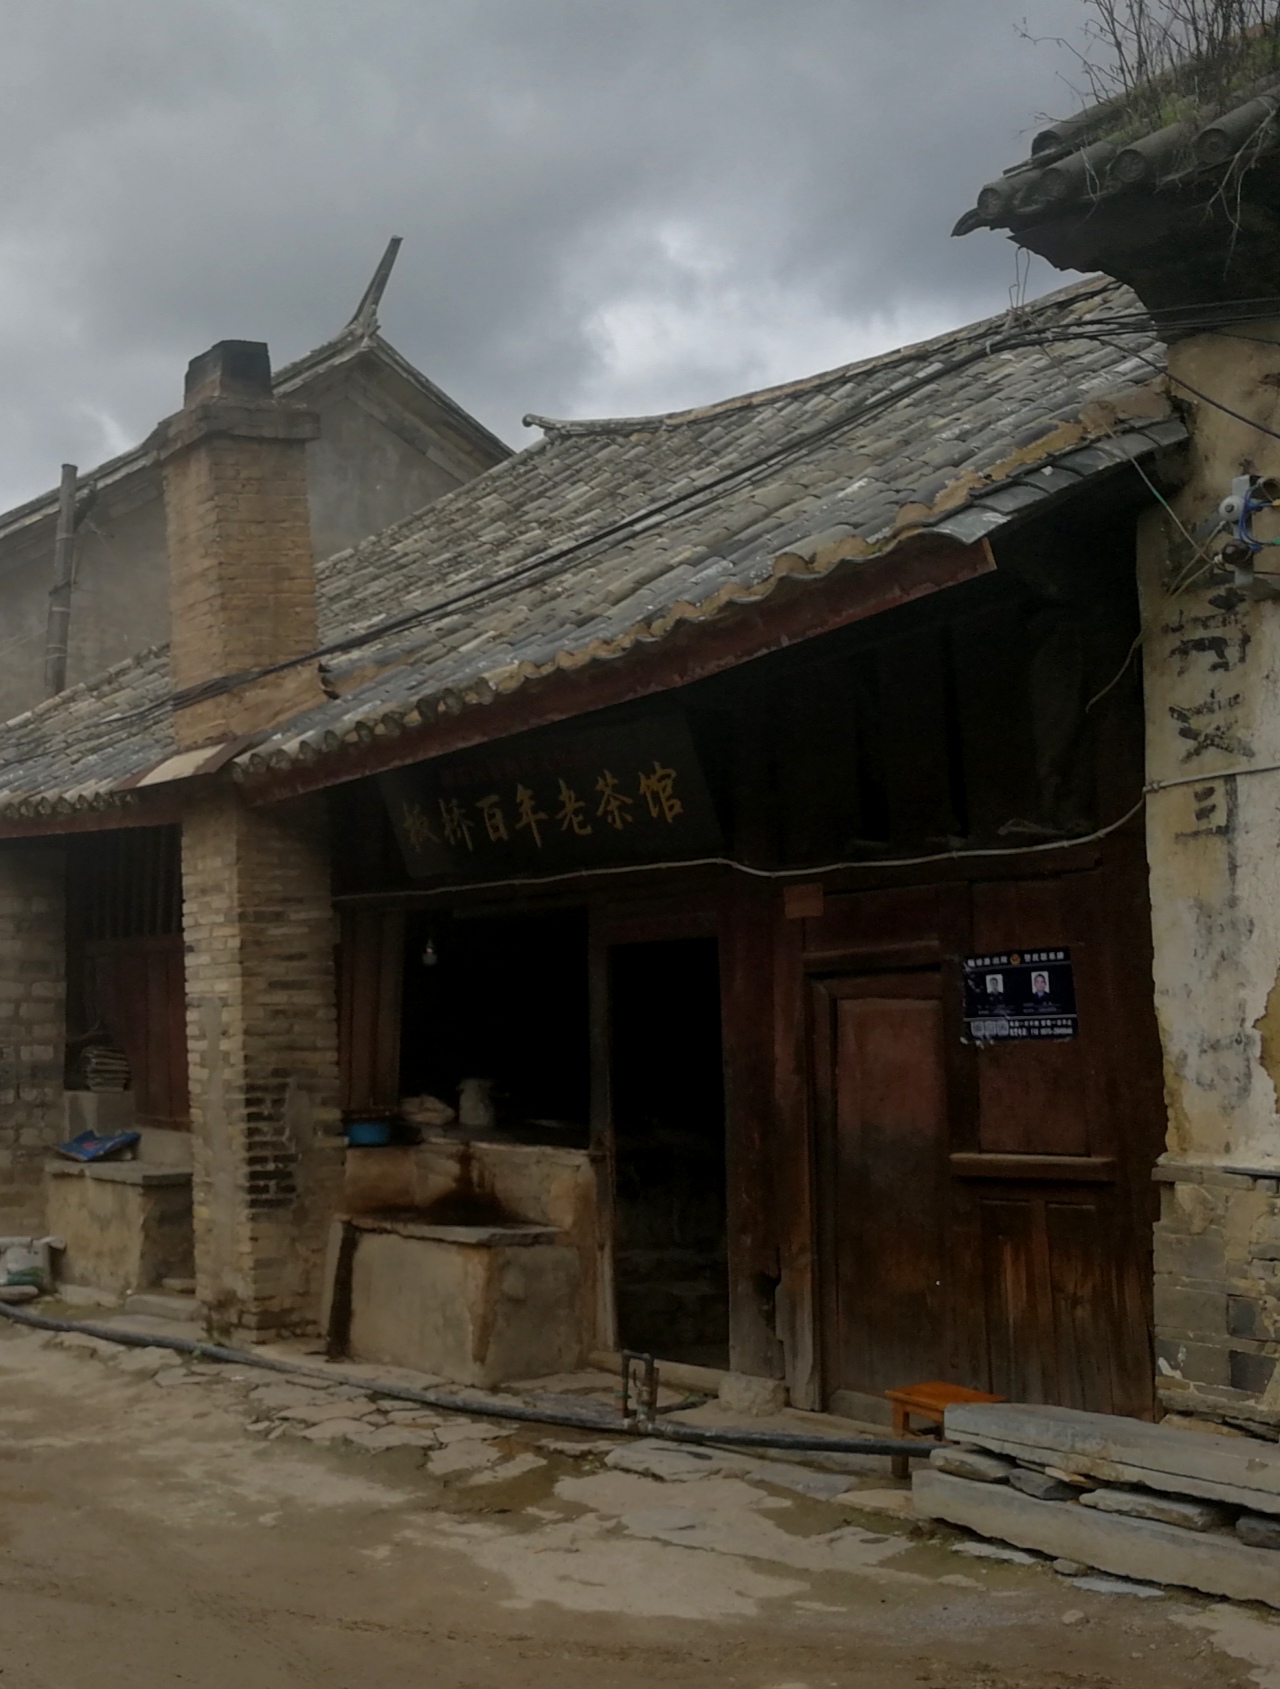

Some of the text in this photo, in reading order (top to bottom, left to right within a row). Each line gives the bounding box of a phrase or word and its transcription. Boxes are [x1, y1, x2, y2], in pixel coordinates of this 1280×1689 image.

[402, 761, 683, 853] 板桥百年老茶馆
